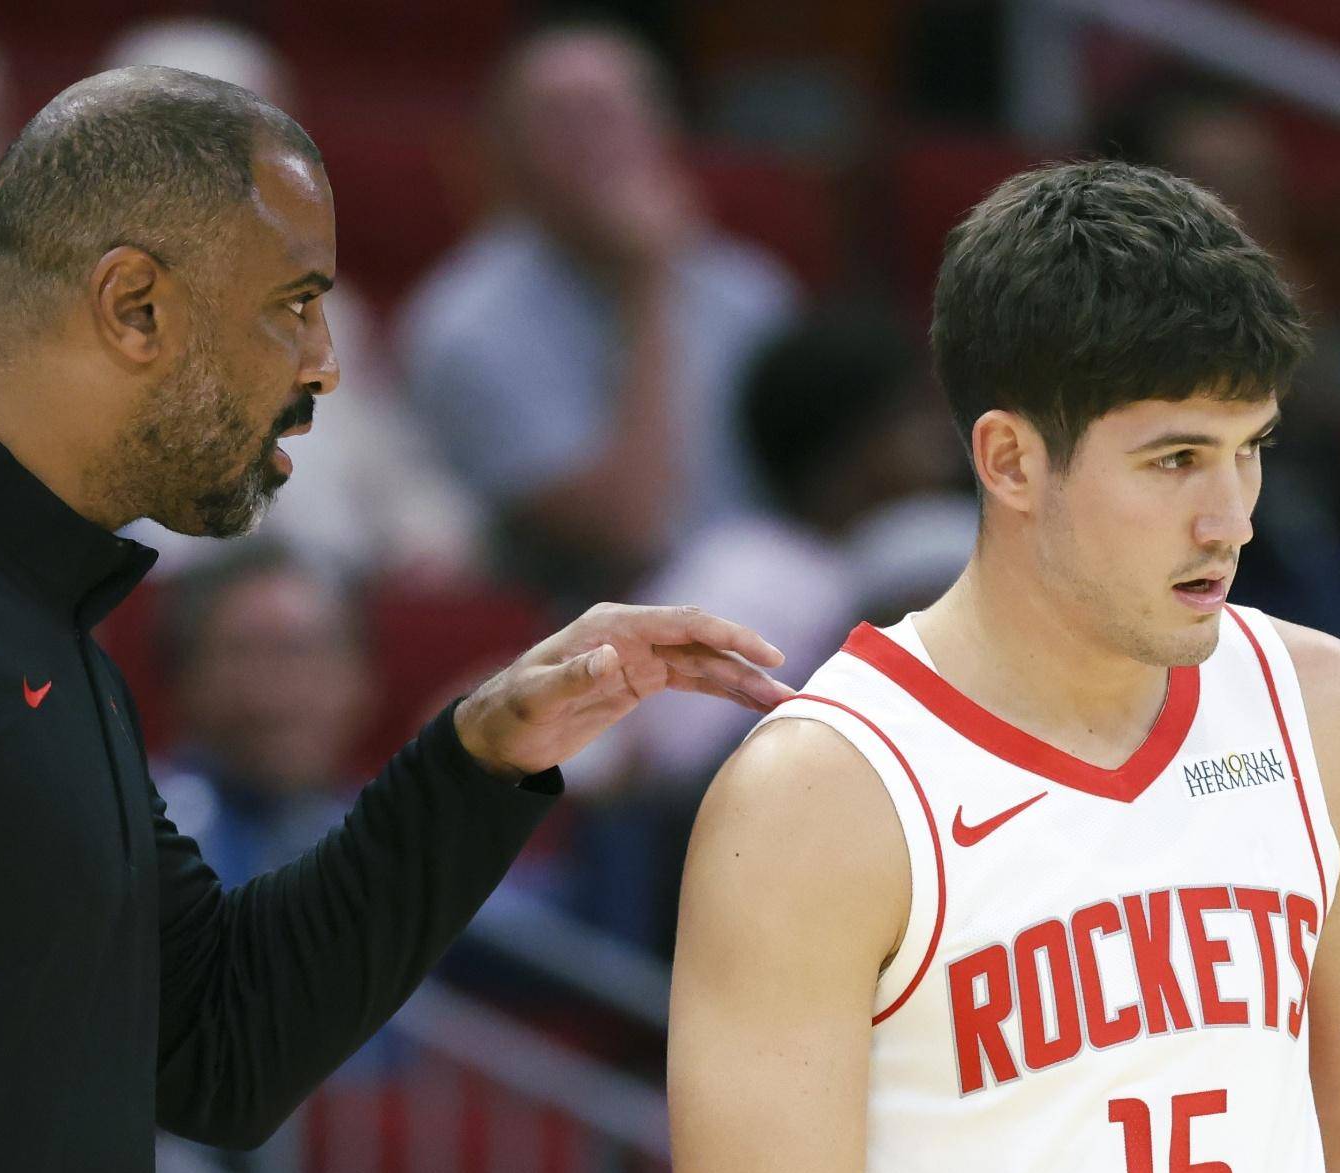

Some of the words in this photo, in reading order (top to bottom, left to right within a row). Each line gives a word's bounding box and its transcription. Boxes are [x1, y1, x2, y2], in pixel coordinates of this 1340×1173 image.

[1183, 748, 1282, 781] MEMORIAL
[1186, 762, 1285, 798] HERMANN
[945, 882, 1320, 1099] ROCKETS
